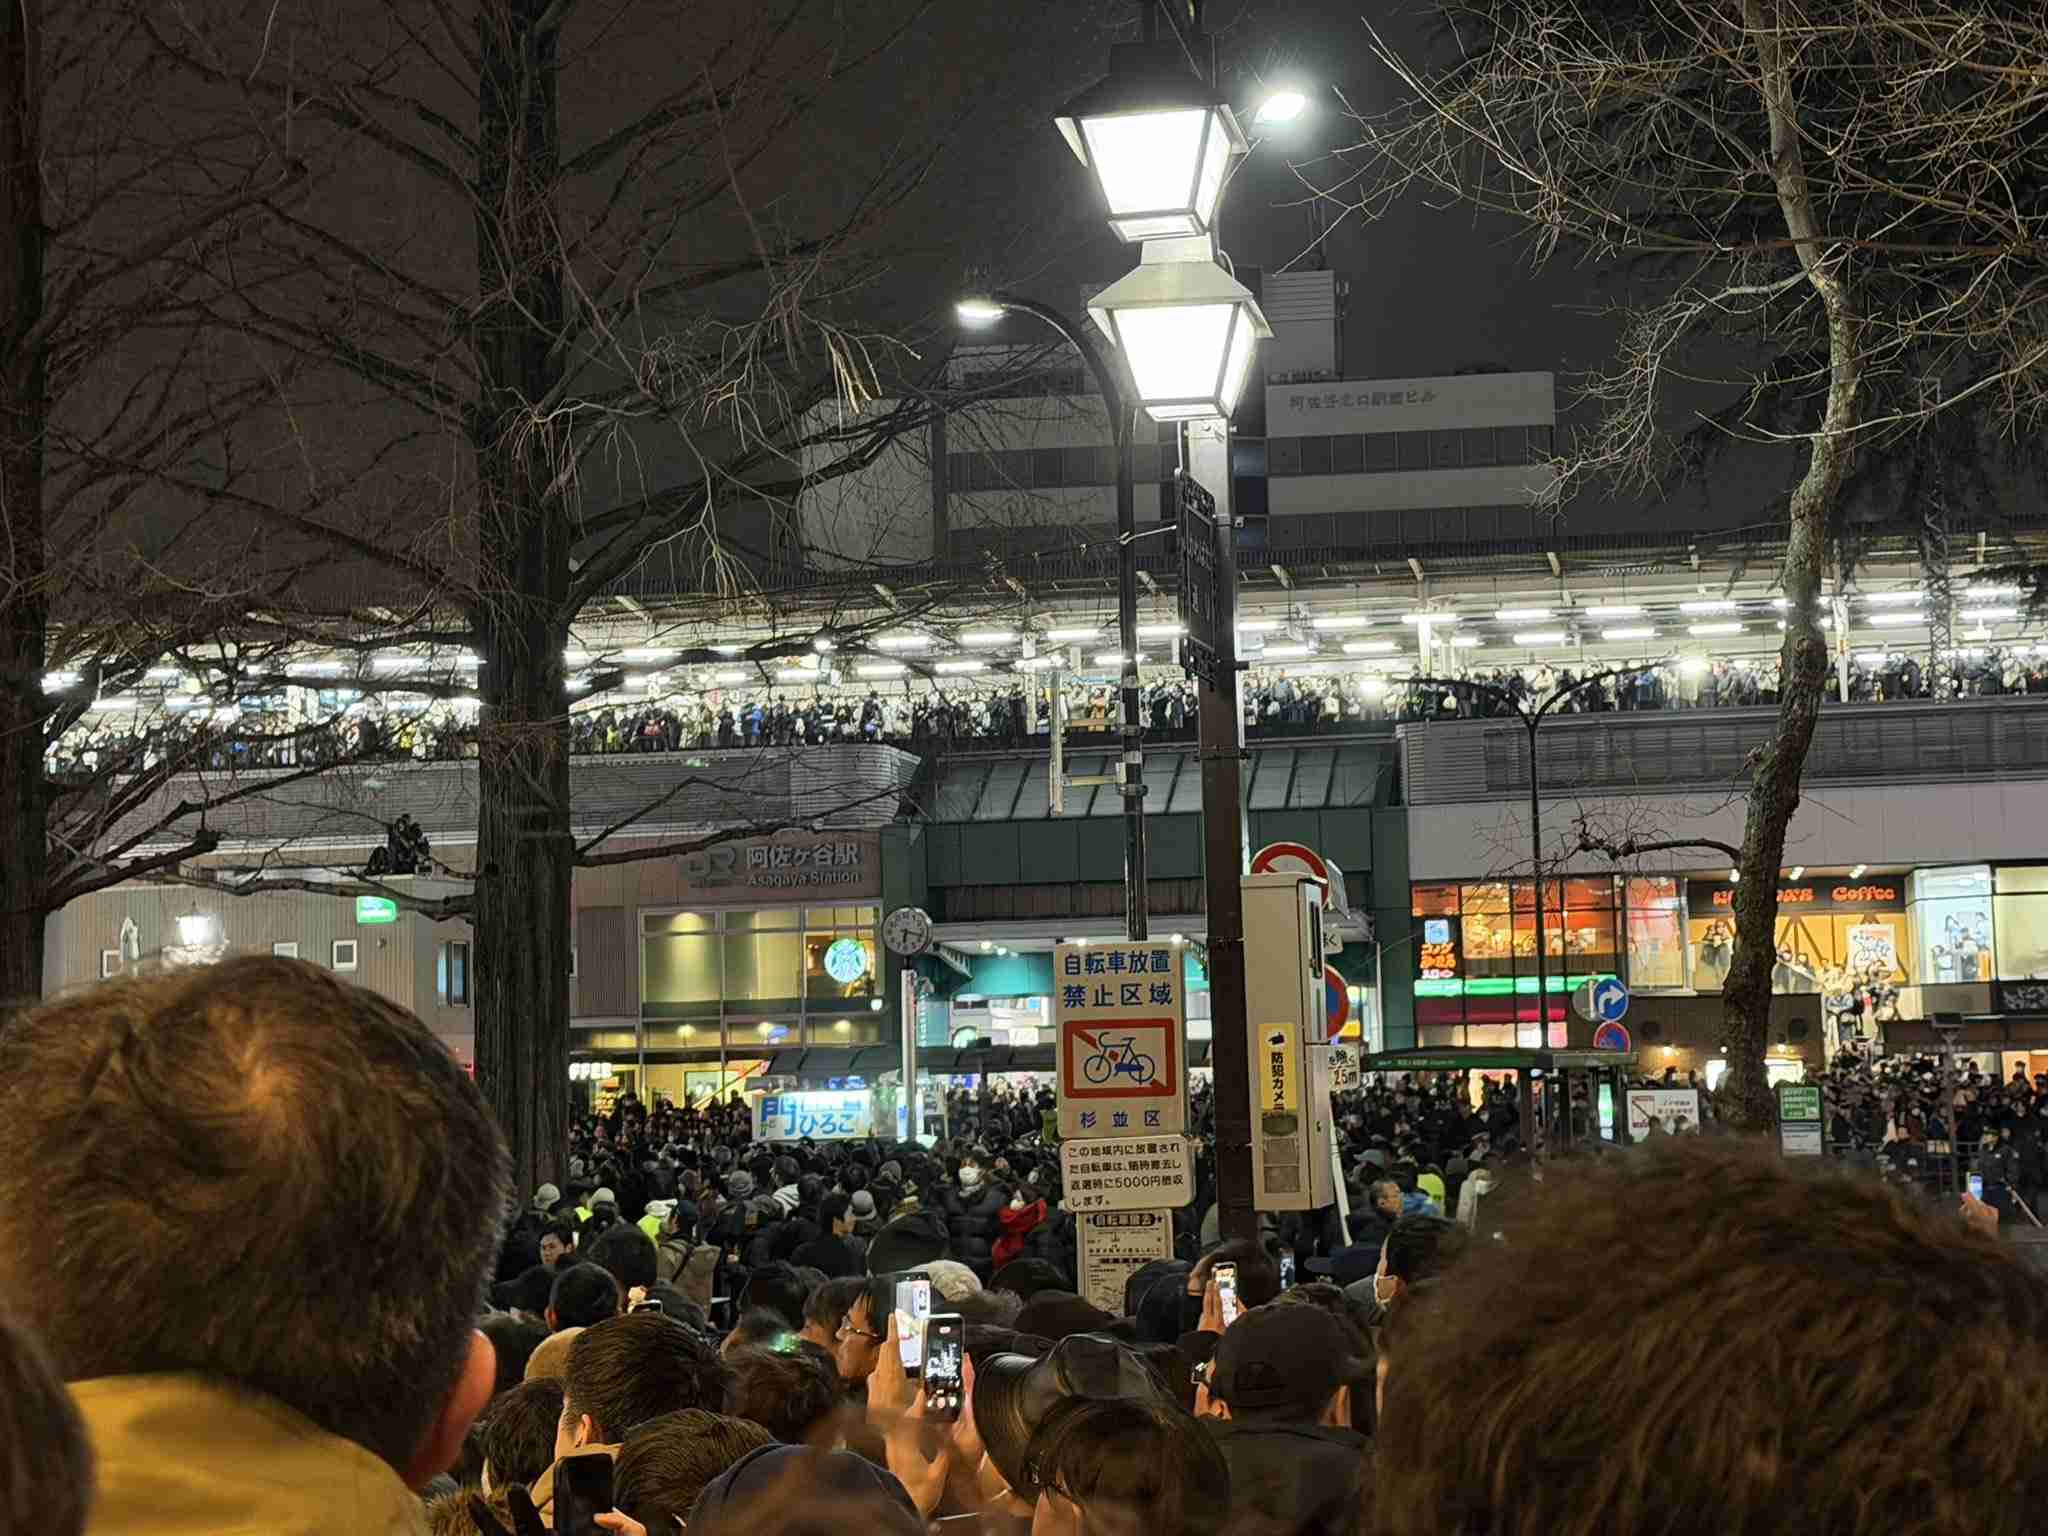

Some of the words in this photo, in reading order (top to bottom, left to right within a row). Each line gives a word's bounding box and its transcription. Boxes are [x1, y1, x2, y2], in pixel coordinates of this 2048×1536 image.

[1064, 949, 1170, 976] 自転車放置
[1062, 981, 1173, 1009] 禁止区域
[1080, 1110, 1161, 1129] 杉並区
